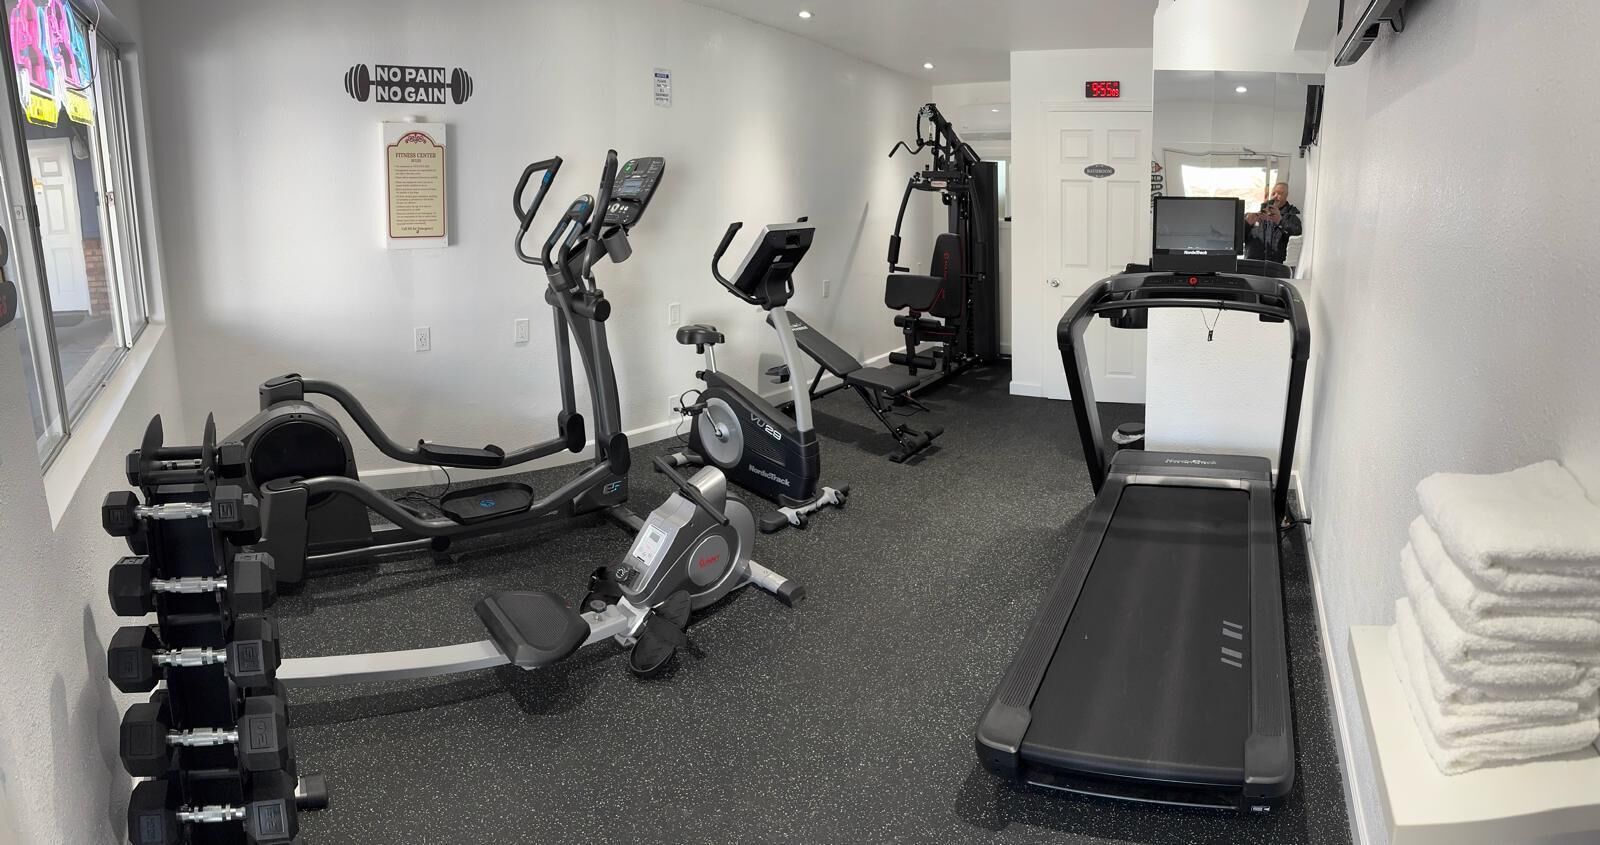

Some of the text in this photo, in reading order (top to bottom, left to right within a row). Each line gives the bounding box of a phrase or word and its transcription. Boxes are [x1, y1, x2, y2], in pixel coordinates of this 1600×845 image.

[376, 66, 445, 84] NO PAIN
[376, 85, 445, 103] NO GAIN
[748, 463, 791, 487] NordicTrack
